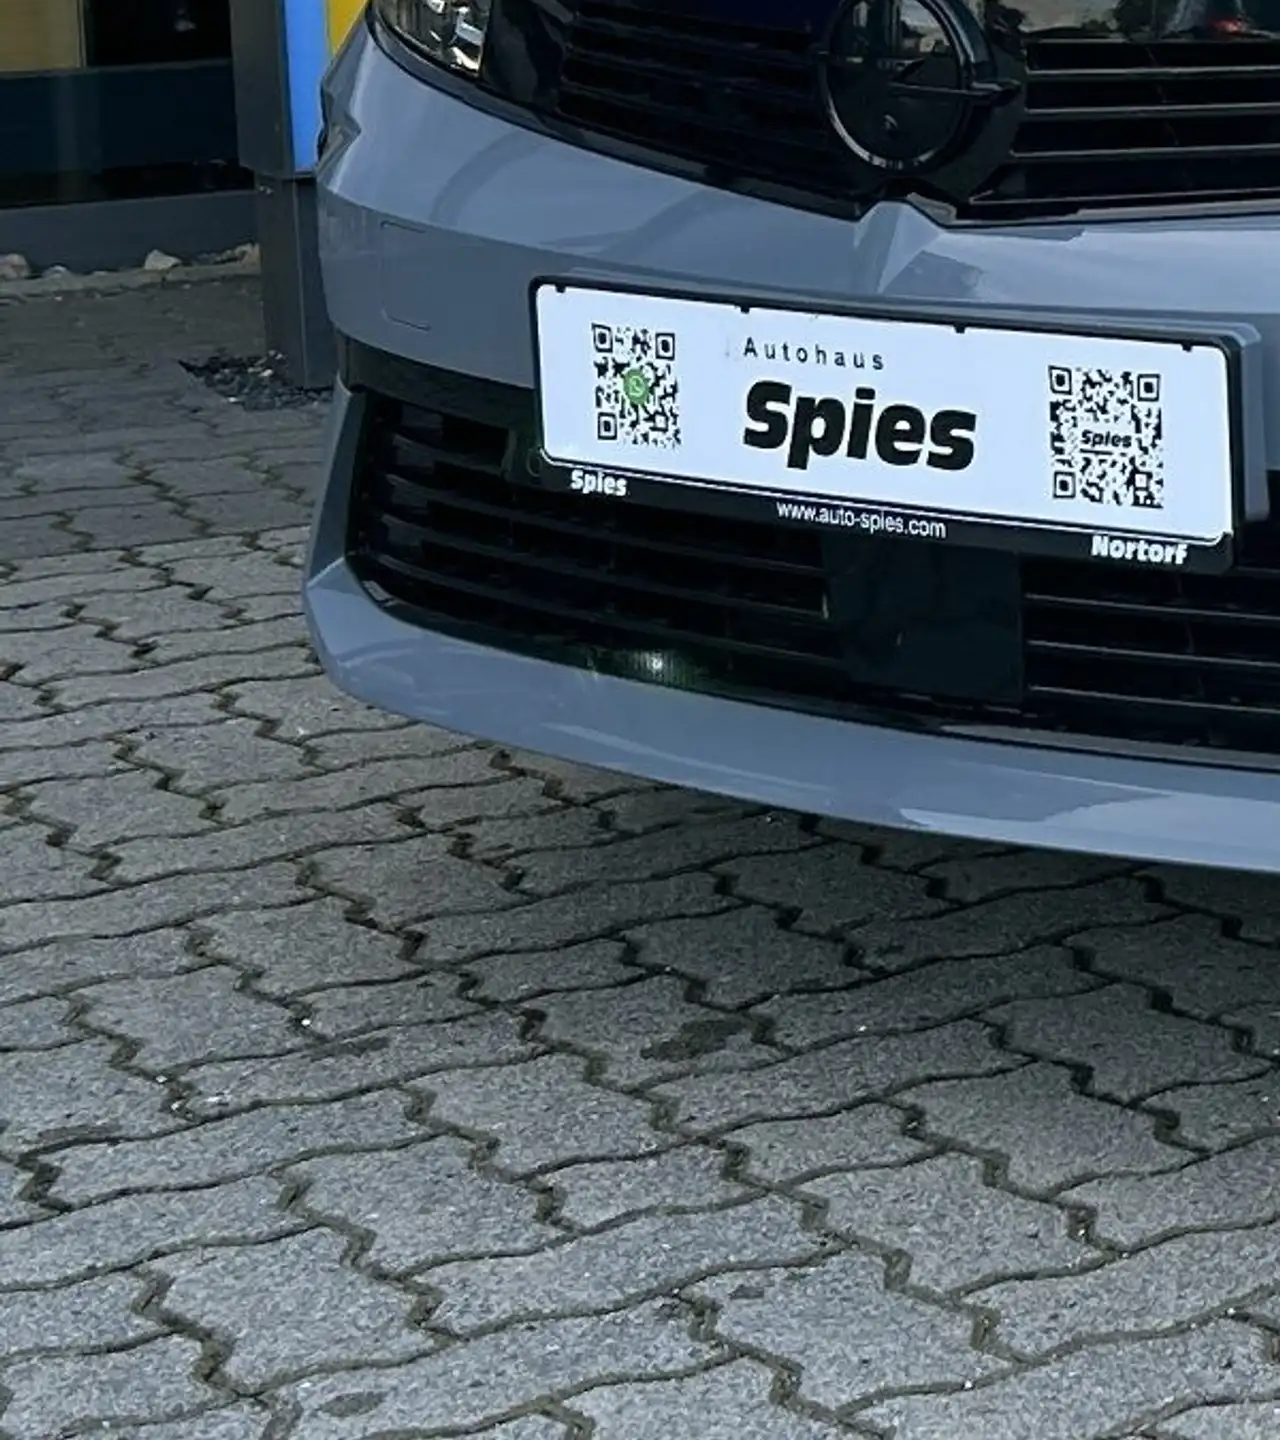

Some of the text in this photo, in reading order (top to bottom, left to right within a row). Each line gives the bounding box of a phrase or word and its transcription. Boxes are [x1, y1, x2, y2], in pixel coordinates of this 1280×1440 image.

[743, 337, 884, 371] Autohaus
[743, 380, 977, 471] Spies
[1081, 429, 1132, 448] Spies
[570, 468, 628, 497] Spies
[776, 500, 947, 539] www.auto-spies.com
[1090, 534, 1188, 565] Nortorf
